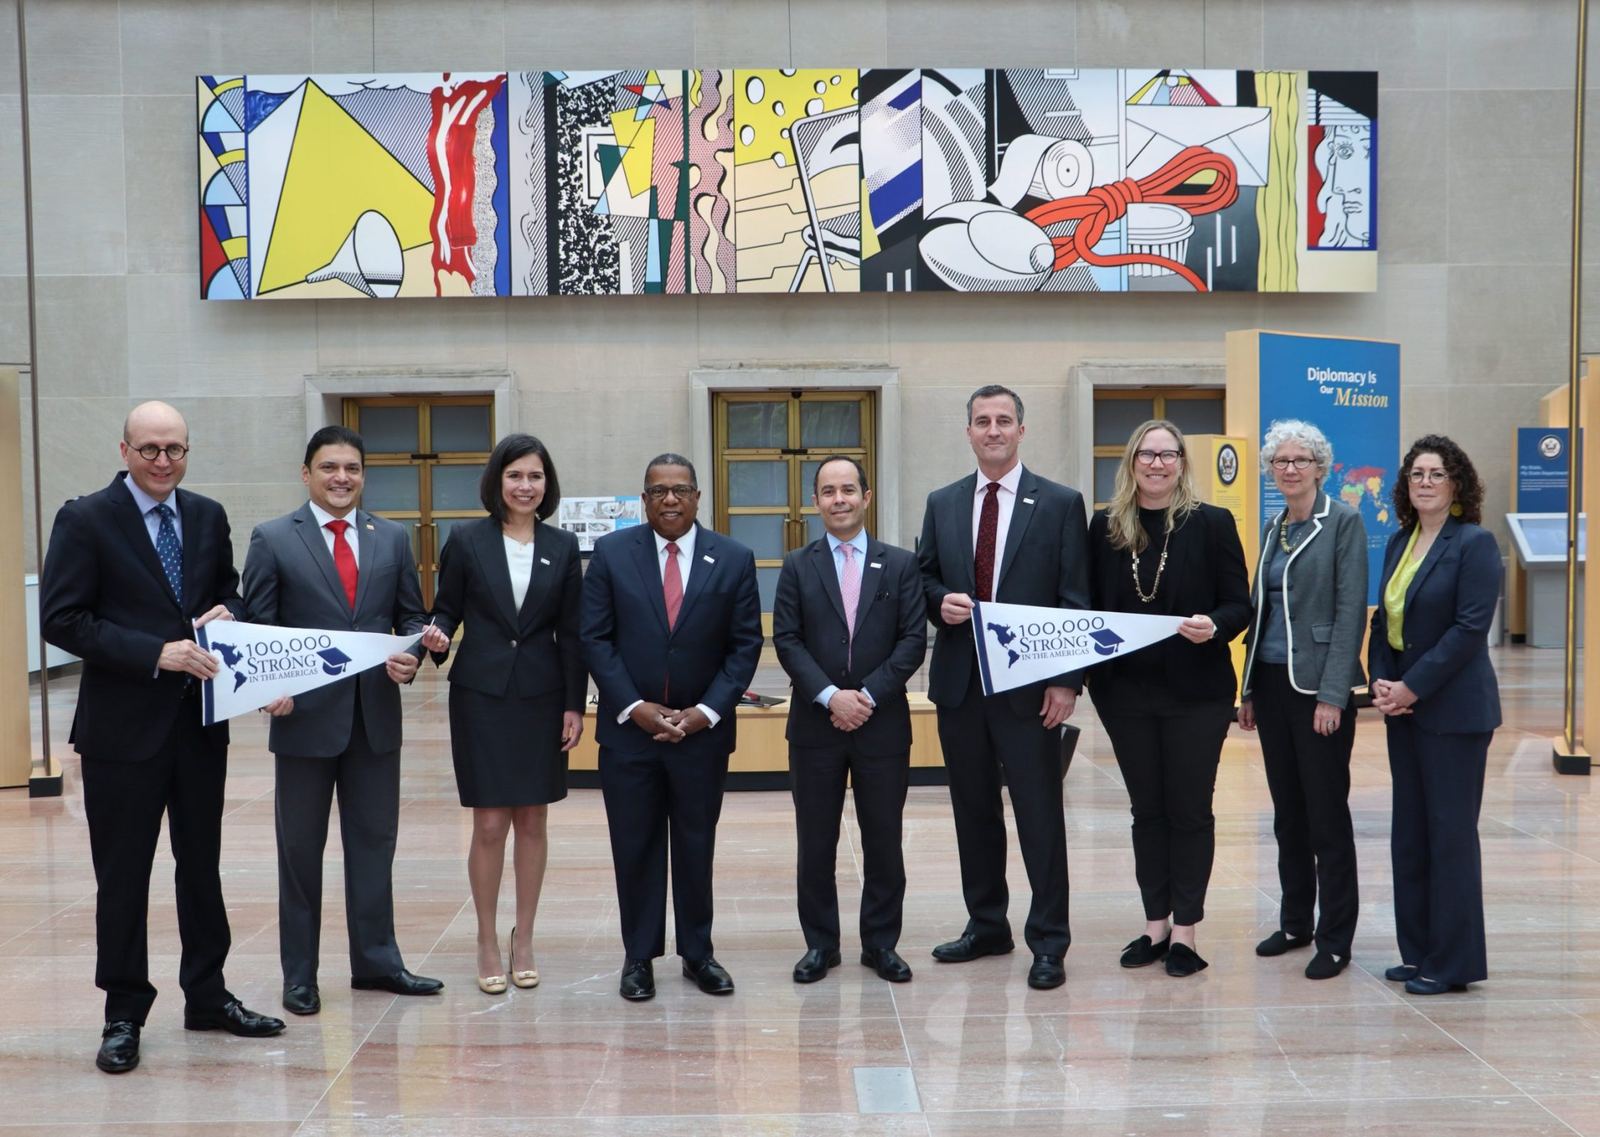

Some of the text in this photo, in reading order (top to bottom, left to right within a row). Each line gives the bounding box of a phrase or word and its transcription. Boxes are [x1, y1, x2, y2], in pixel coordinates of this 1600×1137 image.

[1307, 367, 1377, 386] Diplomacy Is
[1320, 385, 1388, 407] Our Mission
[1018, 616, 1105, 637] 100,000
[246, 634, 331, 657] 100,000
[1019, 635, 1089, 653] STRONG
[247, 653, 317, 674] STRONG
[1021, 648, 1090, 661] IN THE AMERICAS
[249, 668, 319, 684] IN THE AMERICAS
